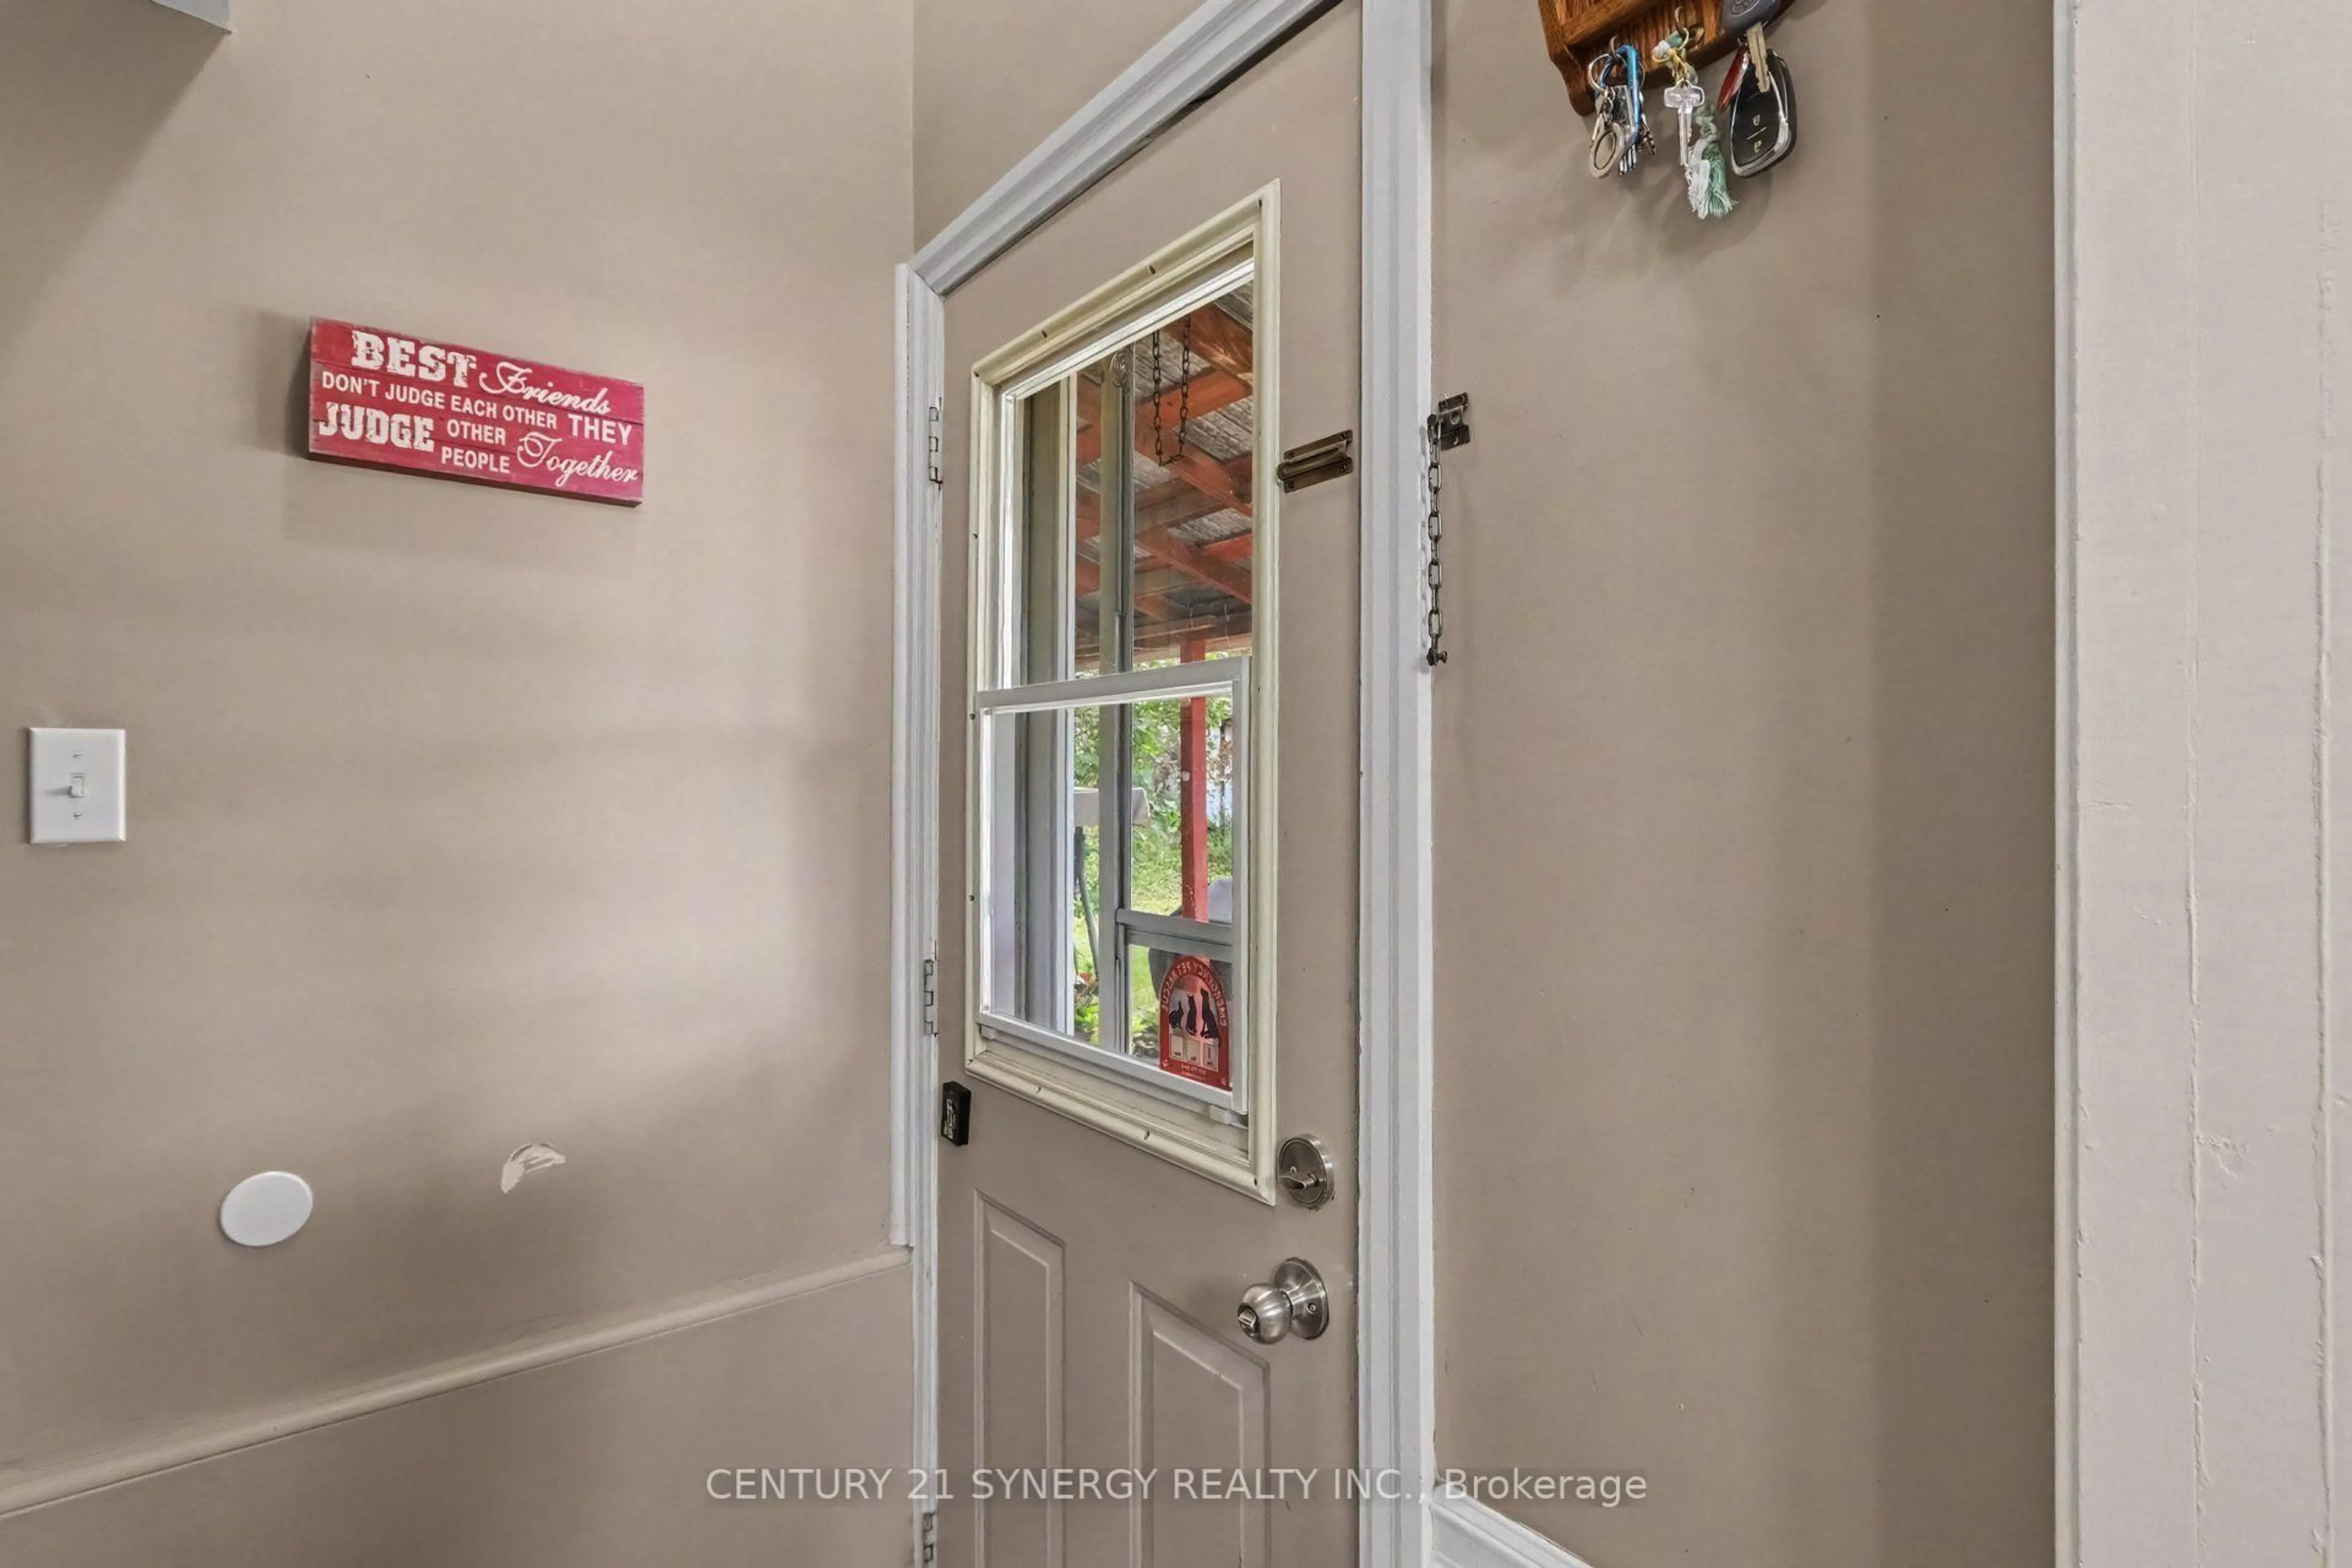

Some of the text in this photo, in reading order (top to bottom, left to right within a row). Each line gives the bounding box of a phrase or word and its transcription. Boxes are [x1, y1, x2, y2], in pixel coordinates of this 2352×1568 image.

[351, 330, 611, 415] BEST Friends
[318, 402, 435, 452] JUDGE
[322, 370, 633, 447] DON'T JUDGE EACH OTHER THEY
[446, 418, 506, 445] OTHER
[440, 445, 510, 474] PEOPLE
[516, 431, 638, 487] Together
